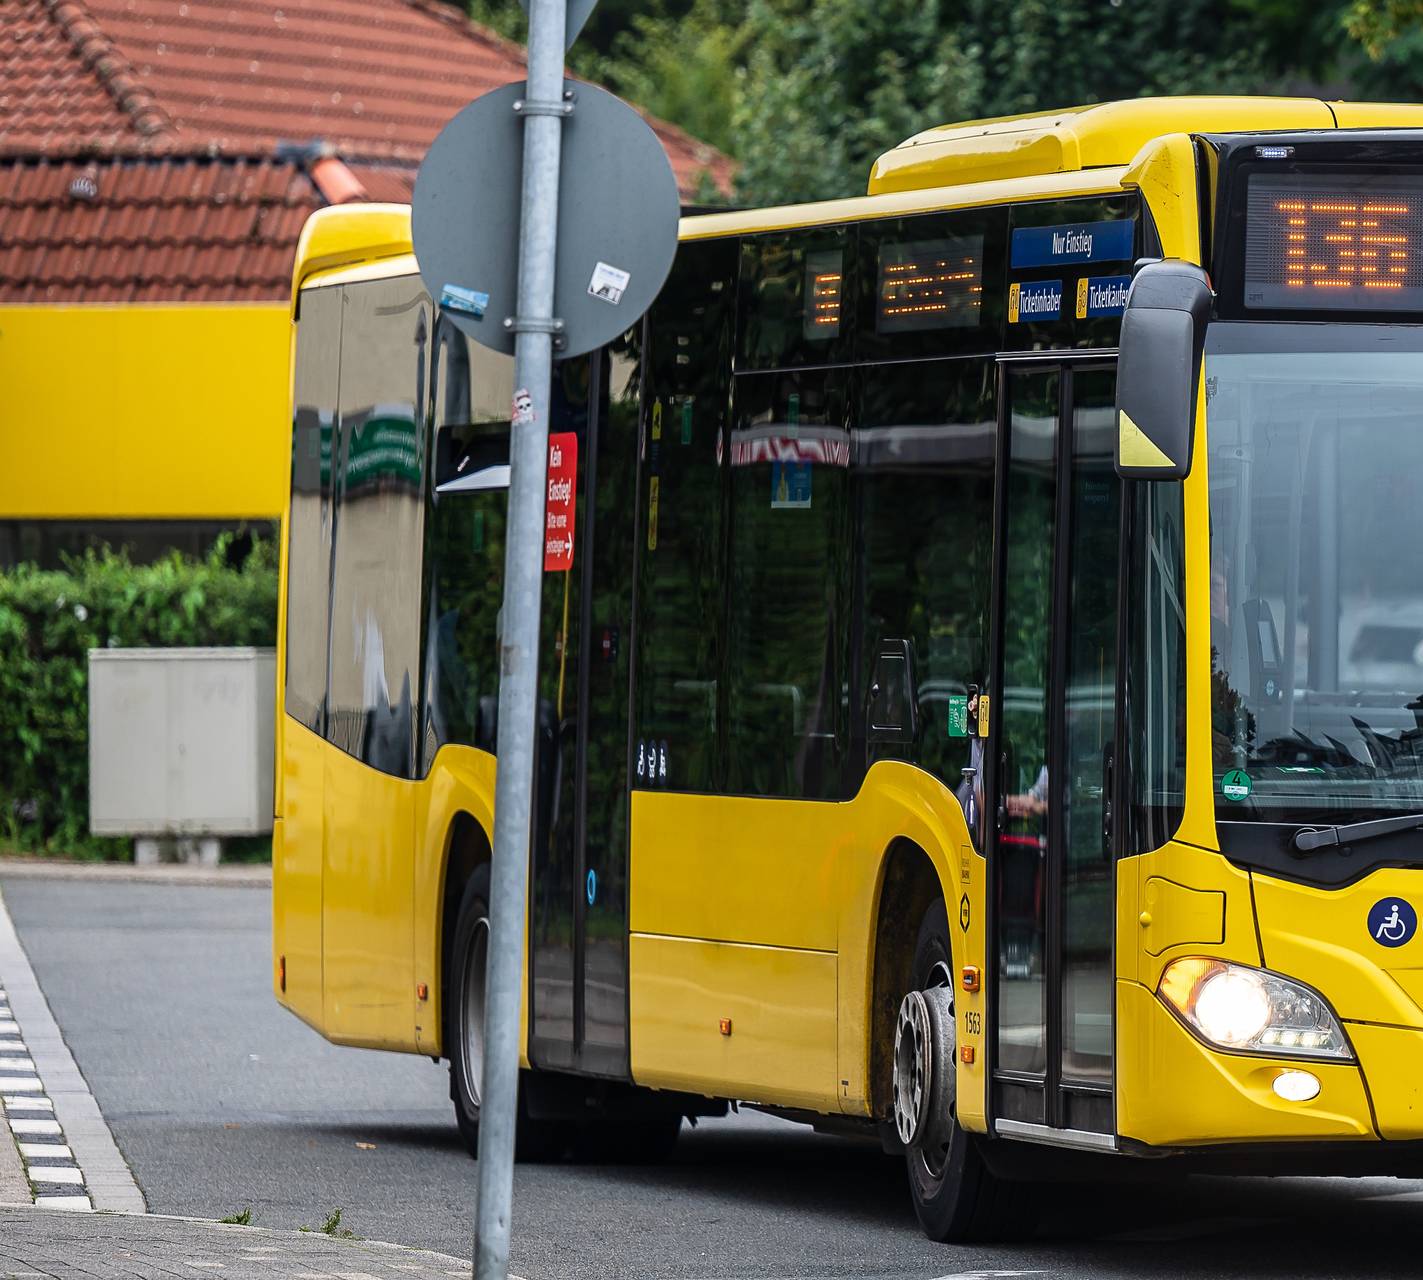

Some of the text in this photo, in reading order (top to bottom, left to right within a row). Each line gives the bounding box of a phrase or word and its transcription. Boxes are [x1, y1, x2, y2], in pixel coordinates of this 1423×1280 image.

[1052, 230, 1093, 258] Nur Einstieg
[1020, 287, 1061, 314] Ticketinhaber
[1231, 770, 1241, 786] 4
[964, 1011, 981, 1036] 1563
